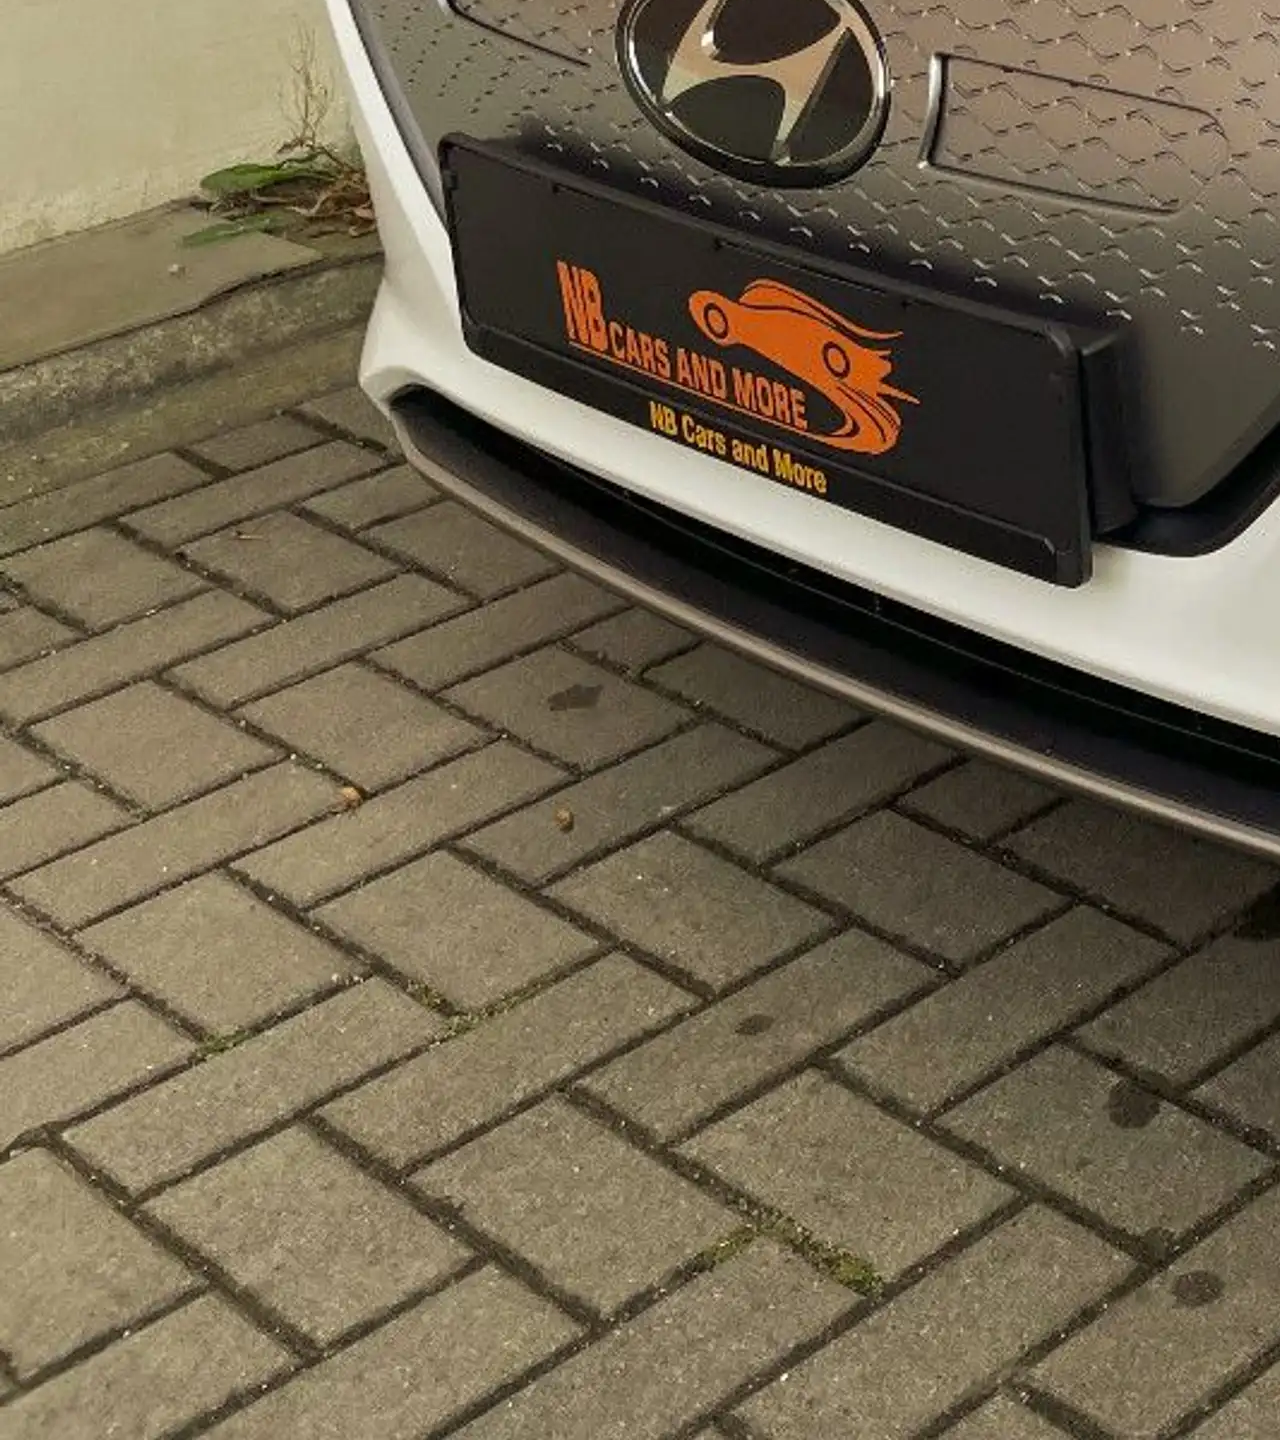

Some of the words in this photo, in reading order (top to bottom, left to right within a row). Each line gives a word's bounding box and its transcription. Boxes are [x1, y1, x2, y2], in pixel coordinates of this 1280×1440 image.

[556, 259, 609, 352] NB
[608, 321, 671, 379] CARS
[676, 347, 728, 399] AND
[731, 367, 808, 430] MORE
[650, 401, 678, 437] NB
[681, 413, 727, 456] Cars
[731, 438, 769, 472] and
[772, 447, 828, 494] More
